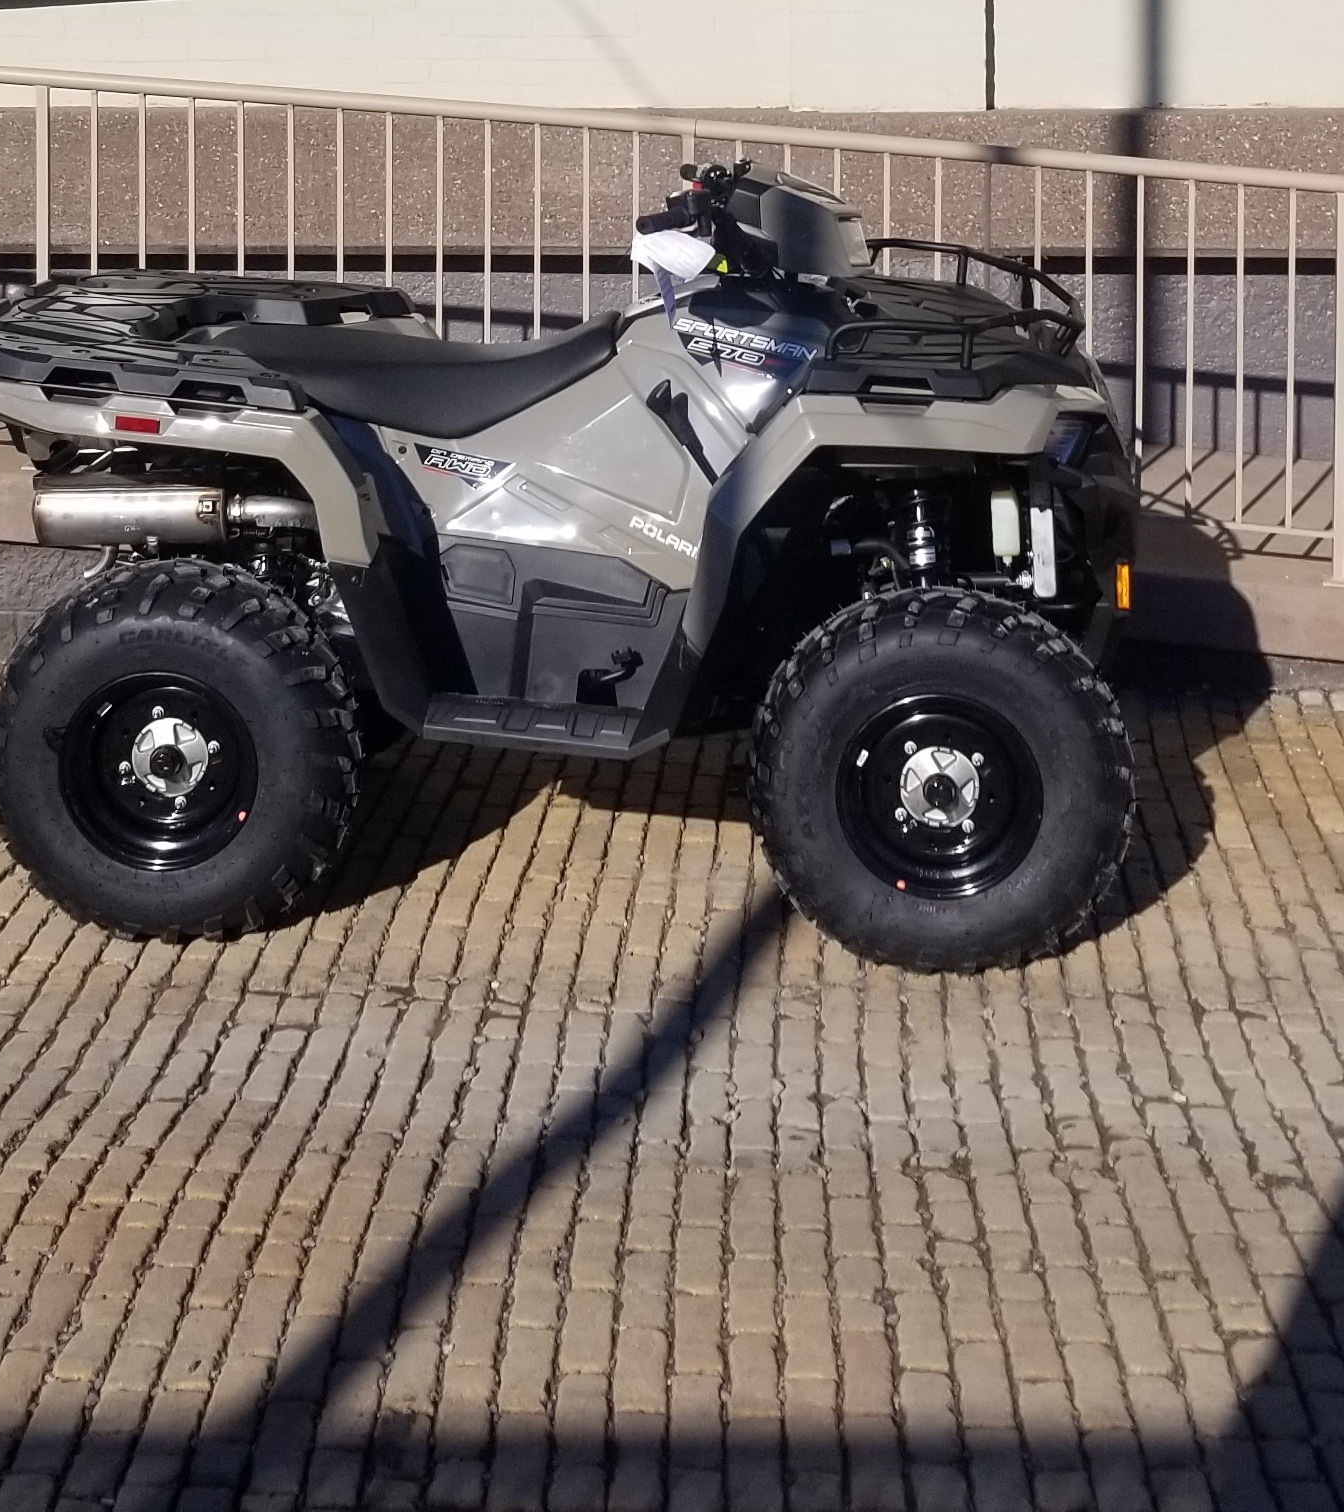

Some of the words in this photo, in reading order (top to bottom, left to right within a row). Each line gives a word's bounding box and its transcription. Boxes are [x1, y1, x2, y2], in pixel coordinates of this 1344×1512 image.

[673, 317, 817, 361] SPORTSMAN
[686, 337, 766, 366] 570
[423, 453, 492, 478] AWD
[628, 515, 699, 560] POLARI
